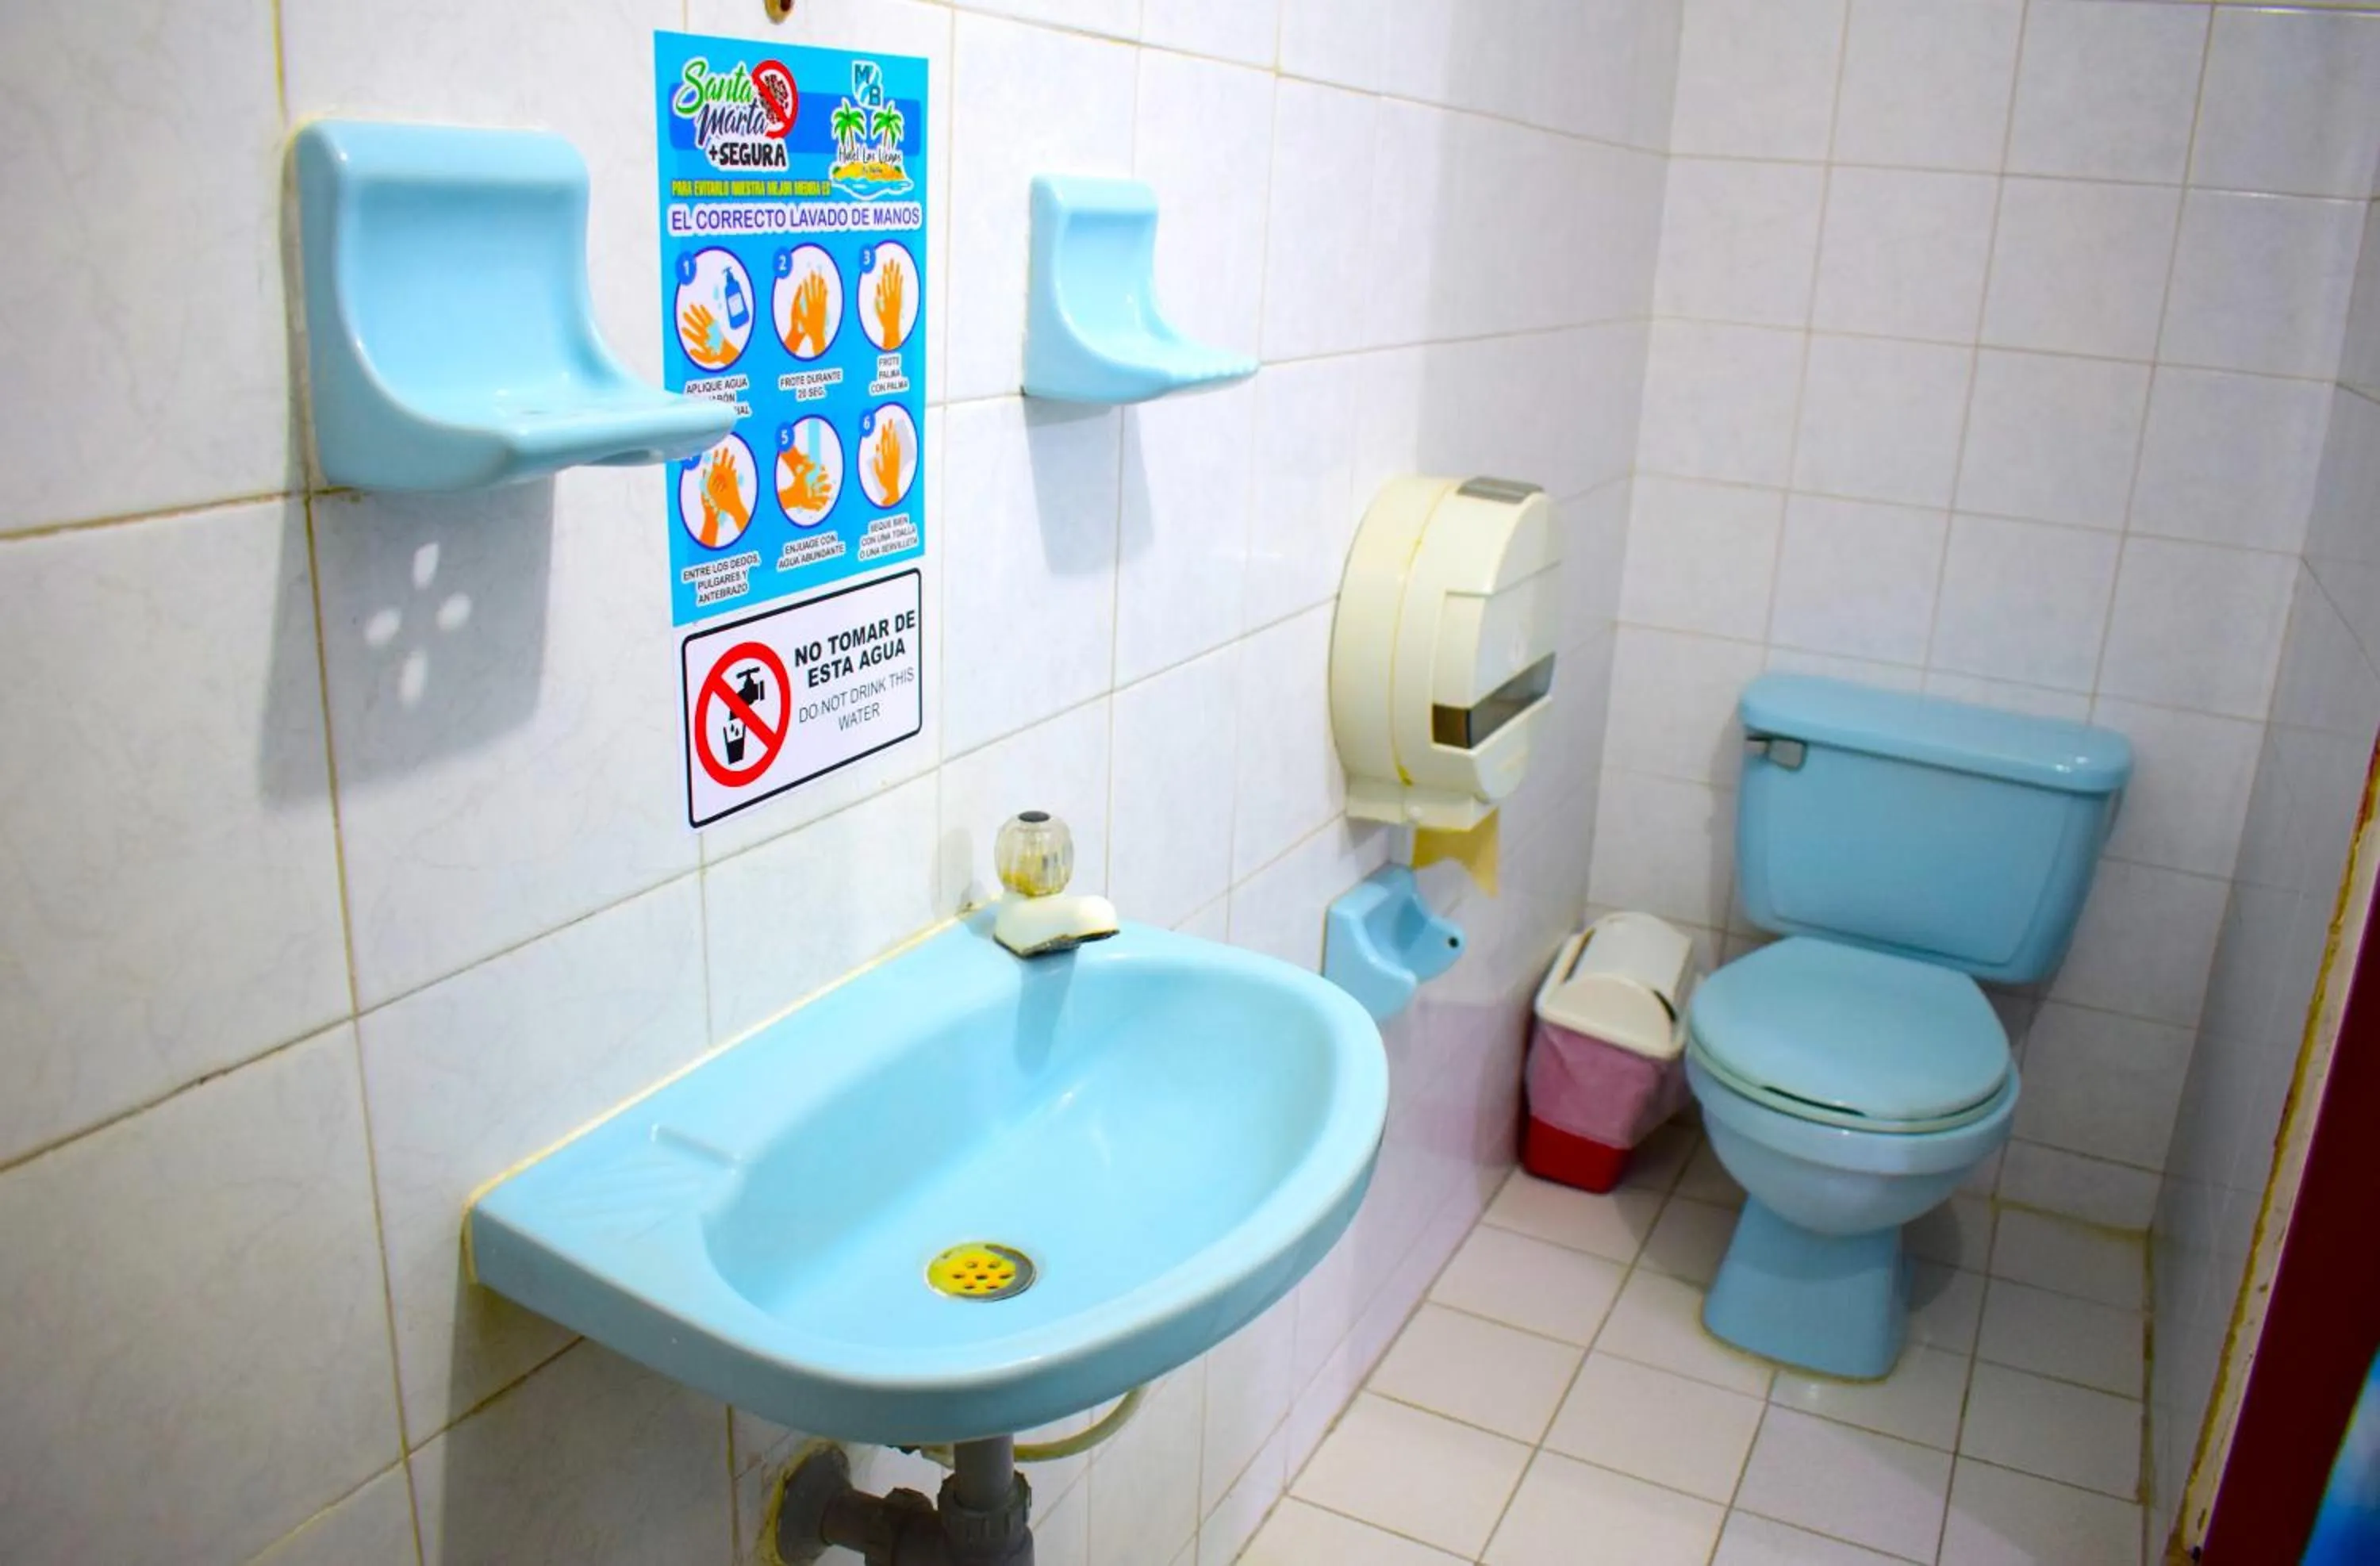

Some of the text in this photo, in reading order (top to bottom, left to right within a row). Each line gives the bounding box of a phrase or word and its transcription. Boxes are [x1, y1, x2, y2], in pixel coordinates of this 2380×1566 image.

[675, 60, 753, 114] Santa
[697, 98, 766, 146] Marta
[672, 207, 919, 230] EL CORRECTO LAVADO DE MANOS
[779, 255, 786, 272] 2
[863, 250, 870, 266] 3
[683, 261, 690, 276] 1
[879, 357, 900, 366] FROTE
[781, 370, 841, 387] FROTE DURANTE
[879, 370, 900, 379] PALMA
[686, 378, 747, 393] APLIQUE AGUA
[871, 381, 908, 393] CON PALMA
[863, 415, 870, 432] 6
[781, 429, 788, 444] 5
[820, 535, 836, 546] CON
[779, 544, 844, 569] AGUA ABUNDANTE
[684, 566, 711, 581] ENTRE
[712, 562, 728, 573] LOS
[698, 572, 740, 589] PULGARES
[699, 583, 747, 602] ANTEBRAZO
[795, 610, 916, 666] NO TOMAR DE
[808, 639, 905, 688] ESTA AGUA
[799, 666, 914, 724] DO NOT DRINK THIS
[839, 702, 880, 731] WATER
